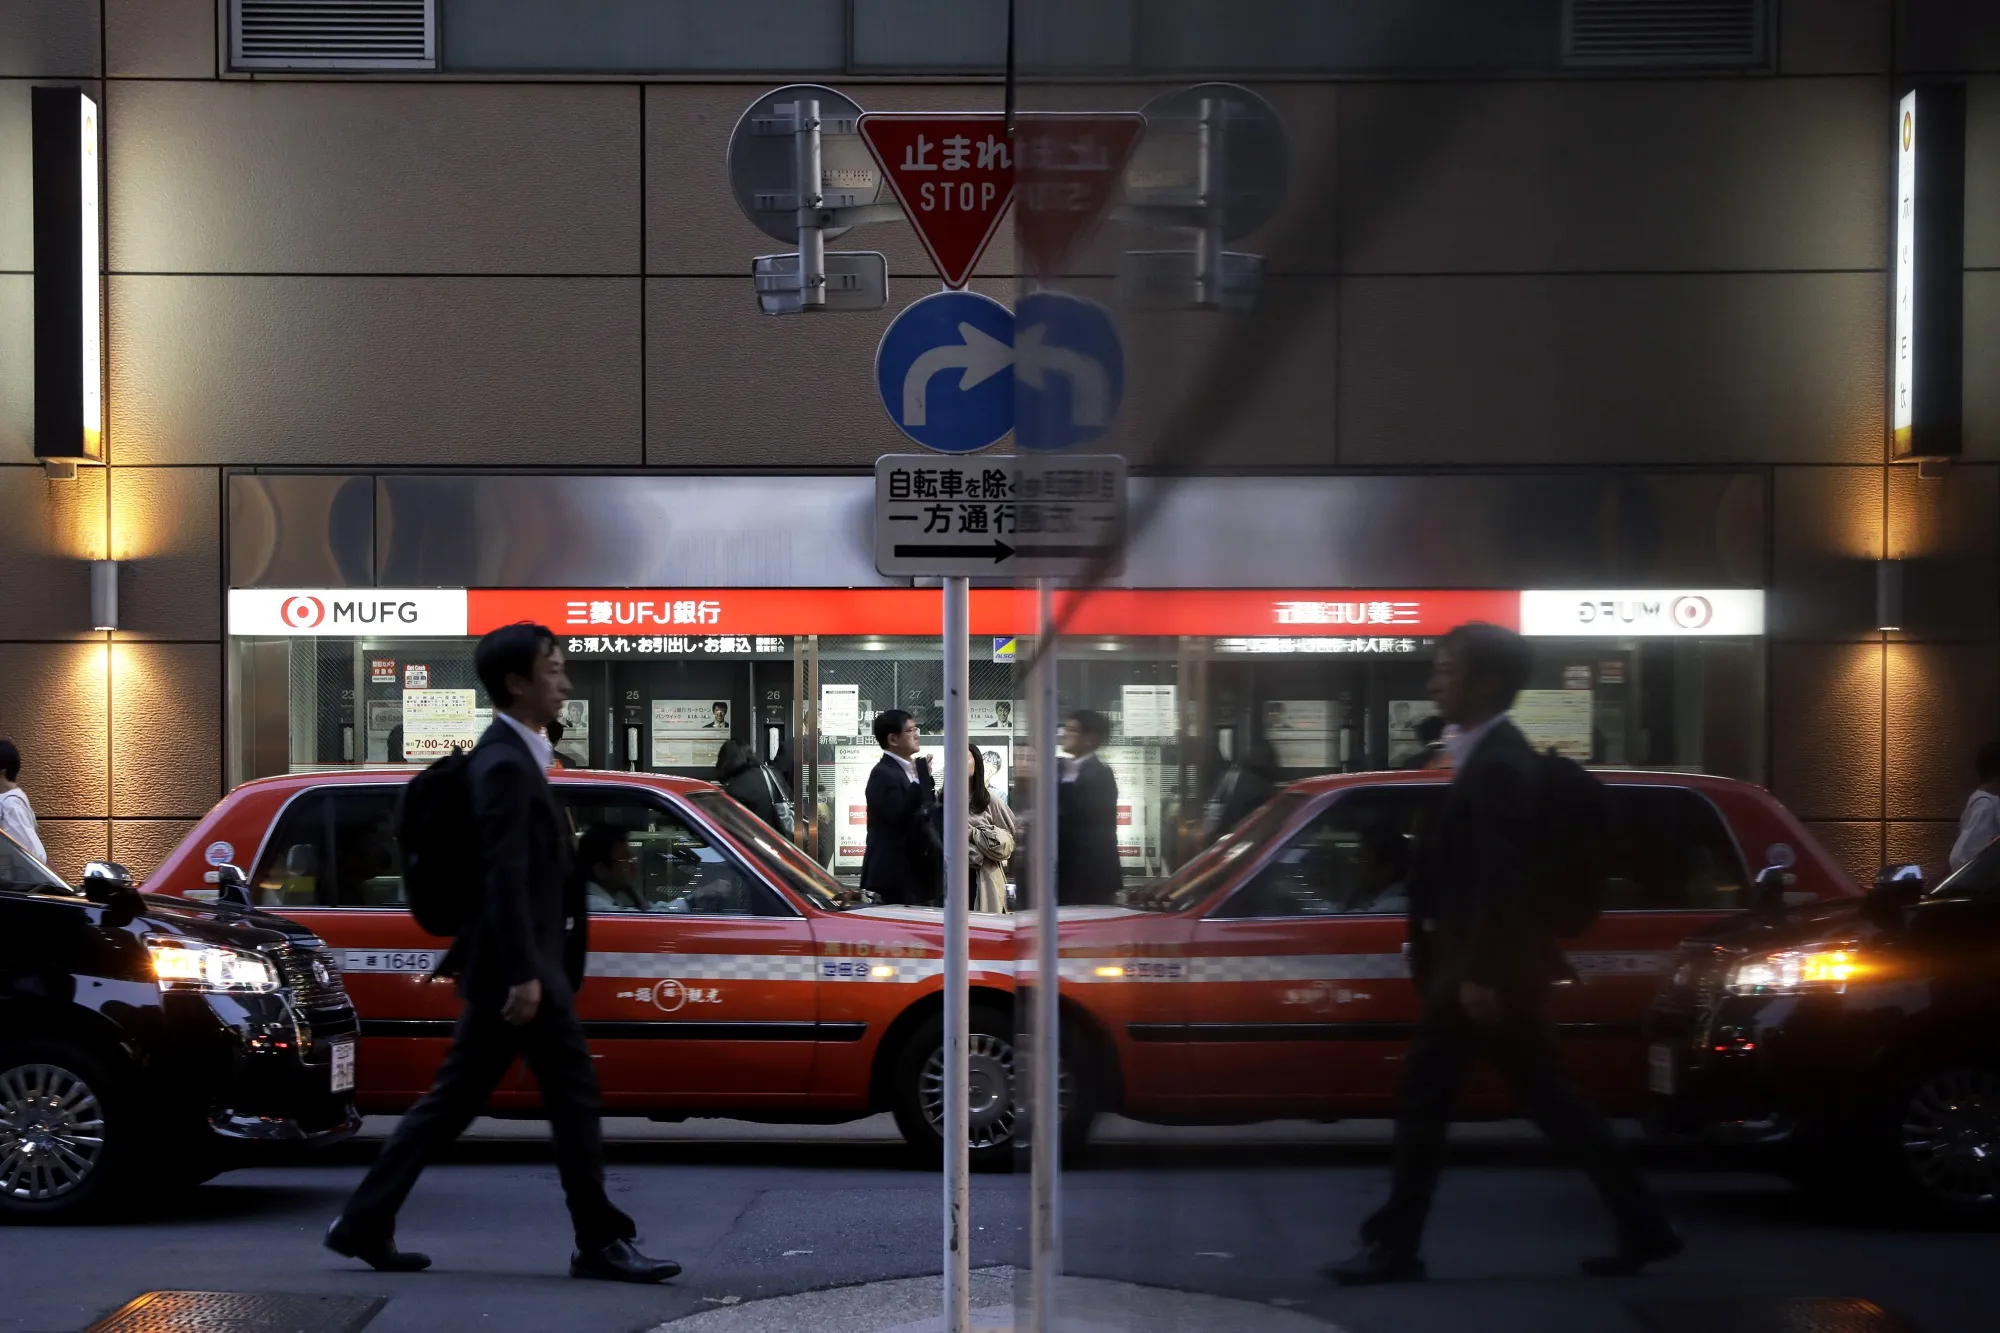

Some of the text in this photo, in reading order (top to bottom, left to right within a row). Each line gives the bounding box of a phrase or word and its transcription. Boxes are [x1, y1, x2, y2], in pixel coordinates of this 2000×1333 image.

[900, 134, 1013, 171] 止まれ
[920, 182, 996, 211] STOP
[889, 468, 1016, 499] 自転車を除く
[889, 503, 1016, 534] 一方通行
[333, 602, 418, 623] MUFG
[566, 601, 721, 624] 三菱UFJ銀行
[568, 637, 751, 653] お預入れ・お引出し・お振込
[626, 690, 640, 700] 25
[767, 690, 780, 700] 26
[909, 690, 921, 699] 27
[382, 953, 430, 969] 1646
